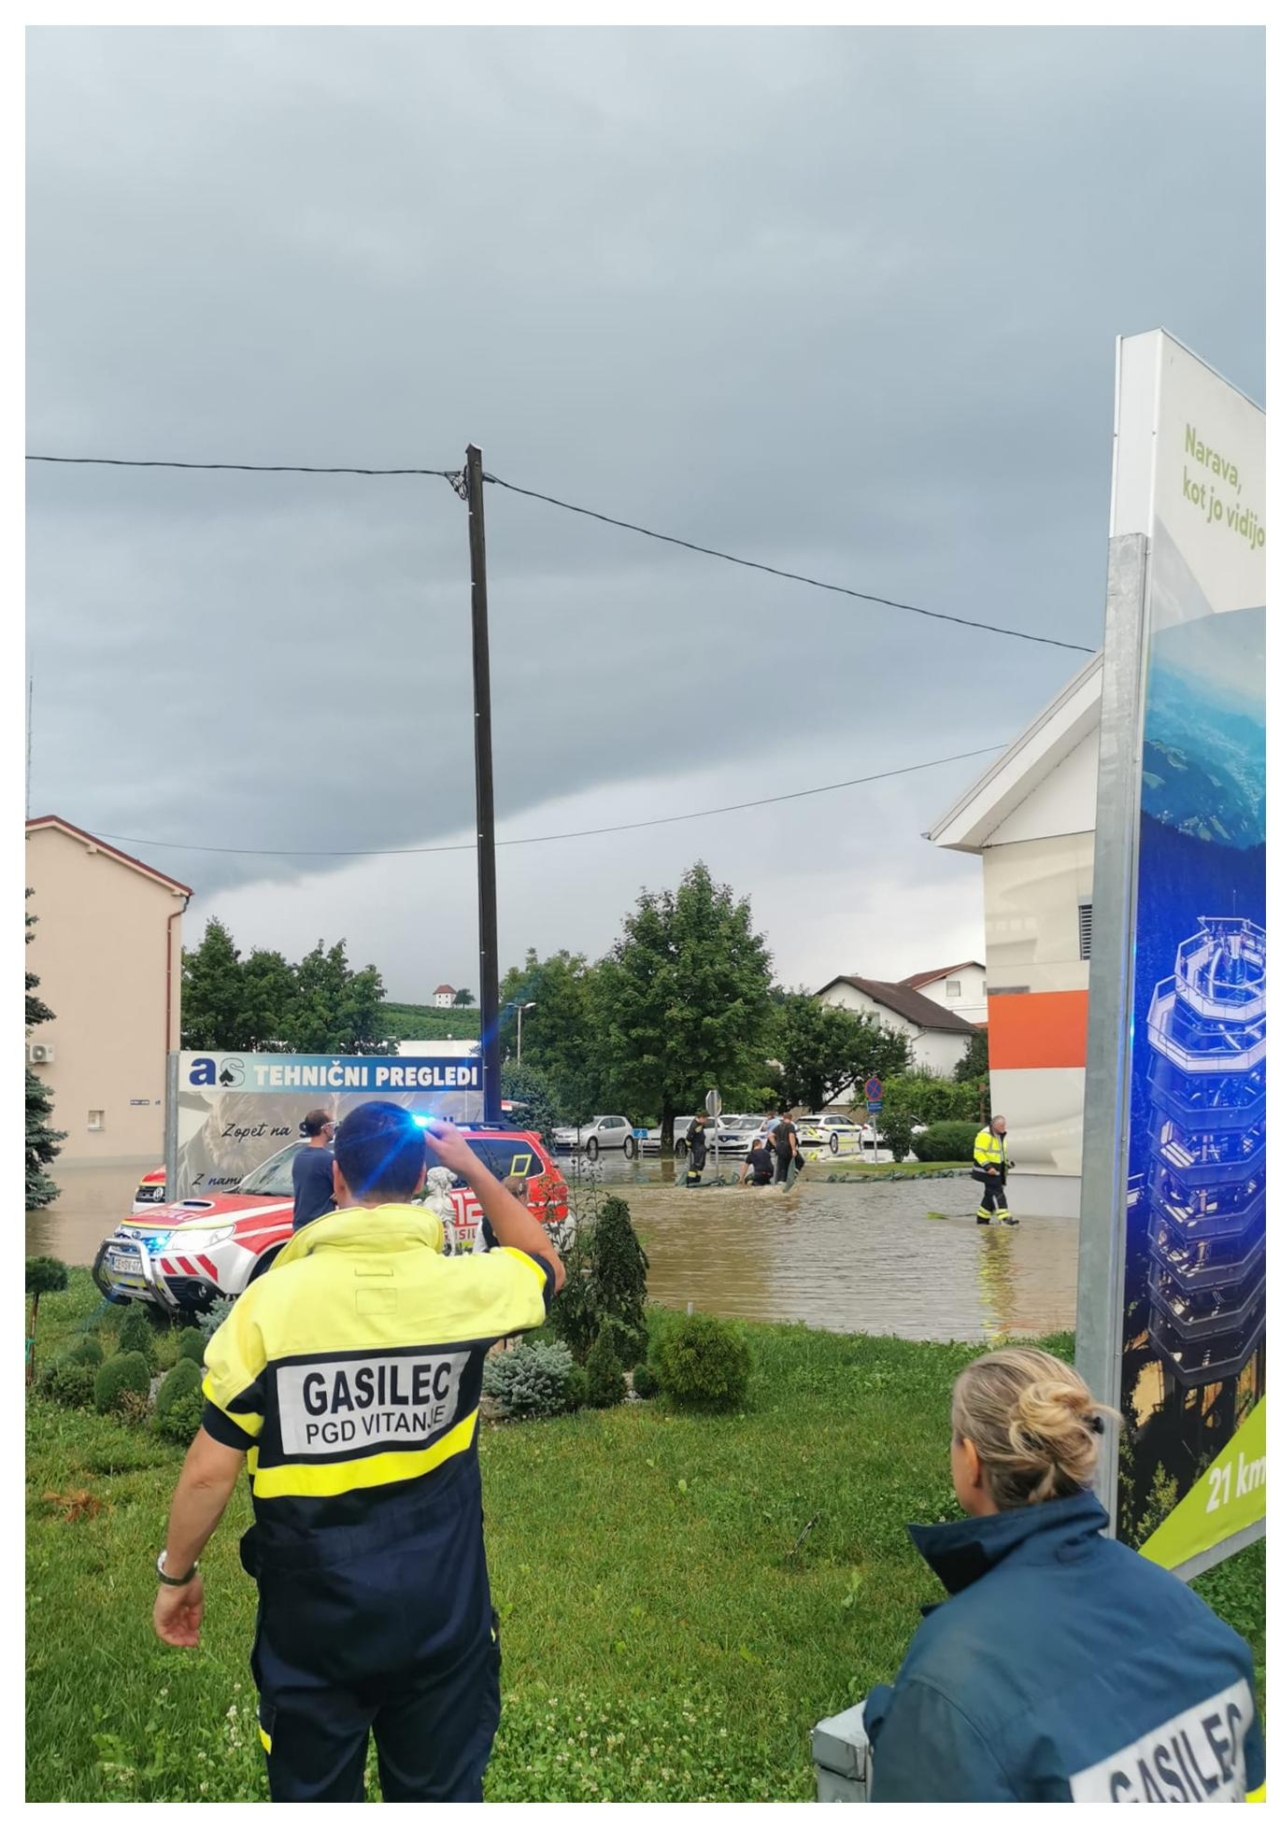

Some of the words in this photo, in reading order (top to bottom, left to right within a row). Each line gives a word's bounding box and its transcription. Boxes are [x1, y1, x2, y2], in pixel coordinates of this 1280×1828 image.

[1185, 422, 1242, 496] Narava,
[1183, 464, 1206, 511] kot
[1206, 485, 1223, 524] jo
[1226, 502, 1266, 551] vidijo
[253, 1060, 368, 1087] TEHNIČNI
[375, 1066, 478, 1087] PREGLEDI
[221, 1122, 269, 1144] Zopet
[269, 1126, 293, 1137] na
[207, 1174, 244, 1186] nami
[302, 1361, 452, 1417] GASILEC
[306, 1420, 356, 1445] PGD
[361, 1405, 447, 1437] VITANJE
[1205, 1460, 1233, 1514] 21
[1236, 1451, 1266, 1499] km
